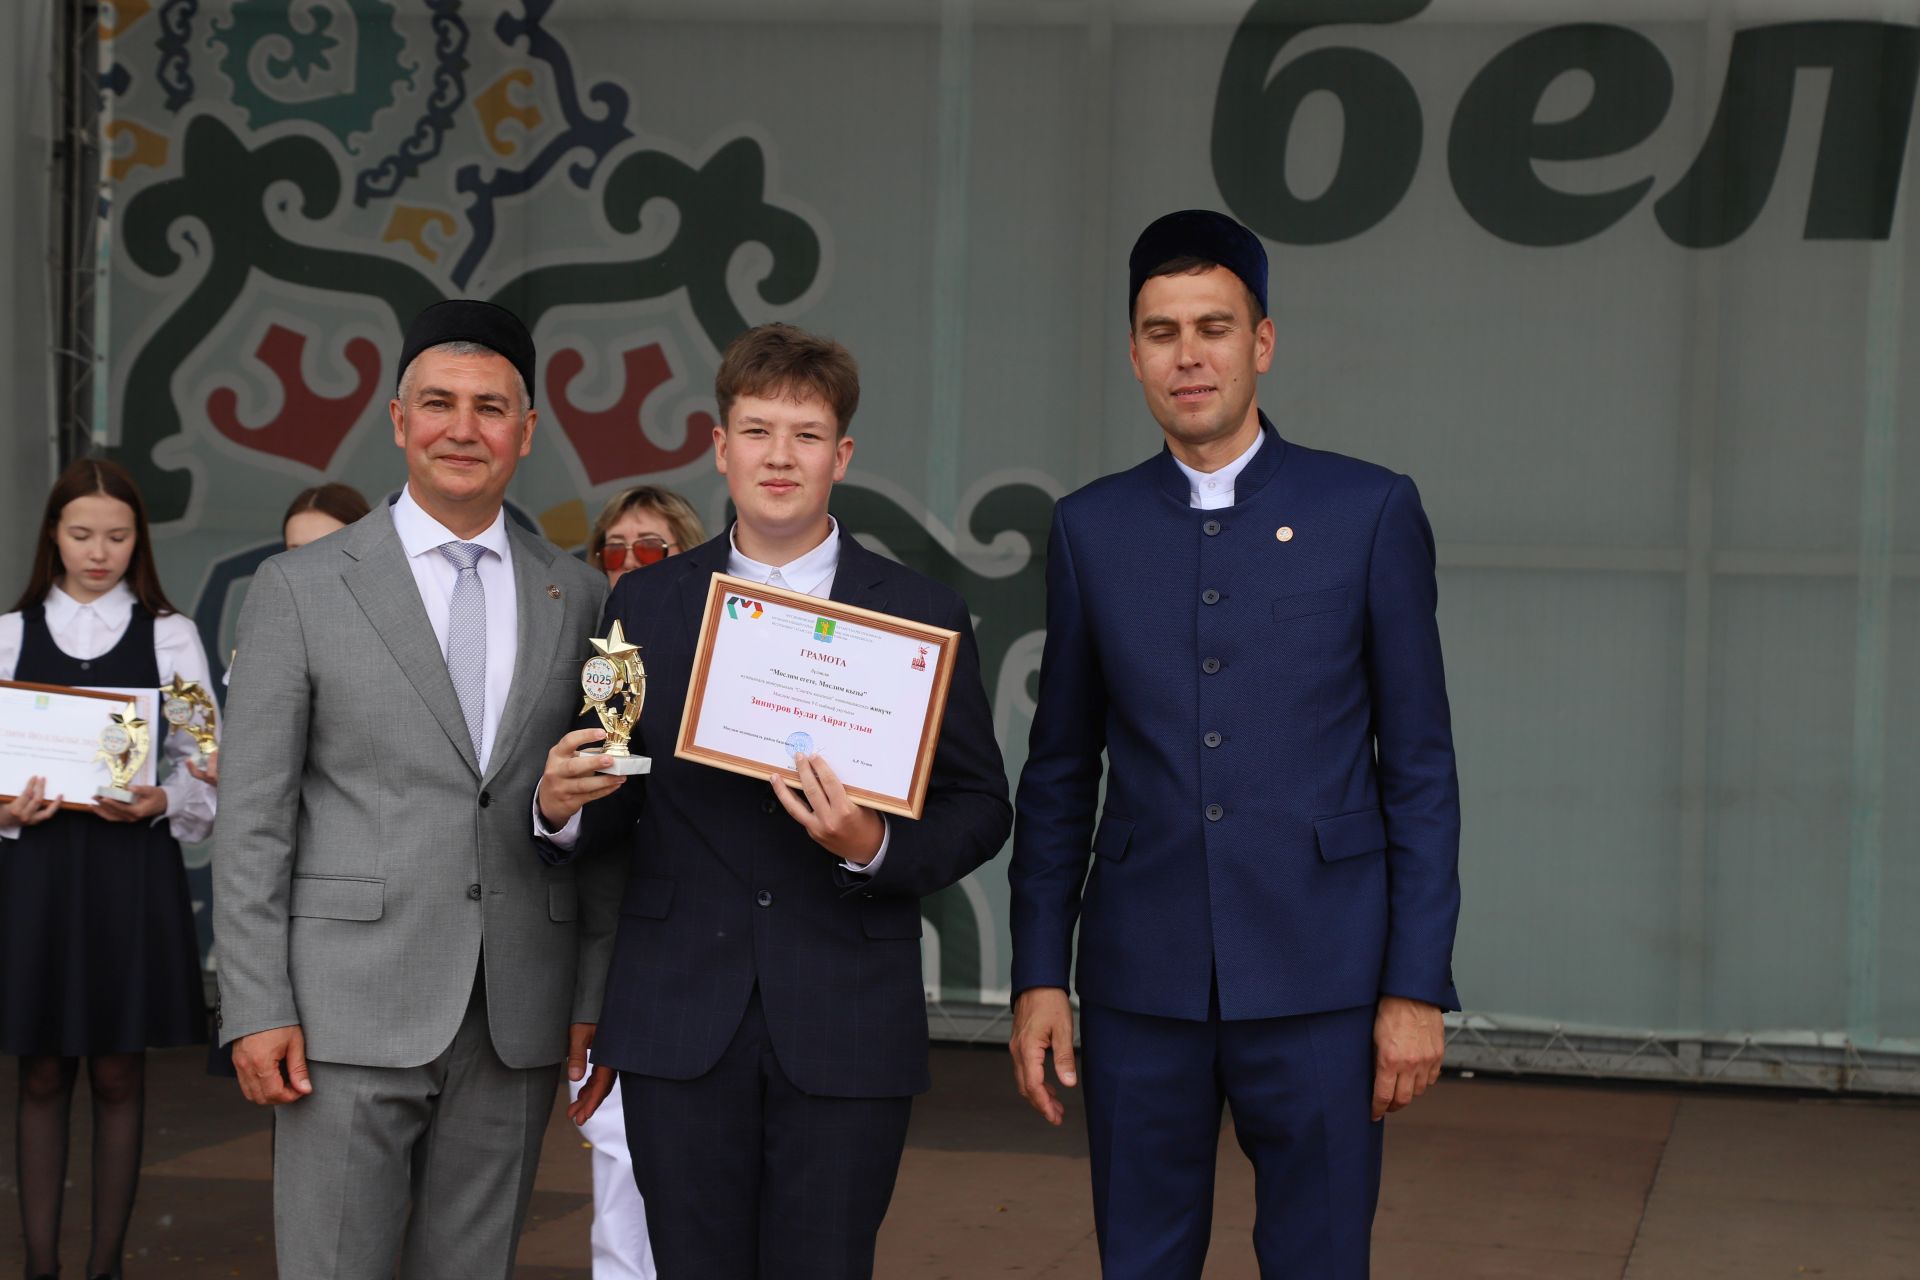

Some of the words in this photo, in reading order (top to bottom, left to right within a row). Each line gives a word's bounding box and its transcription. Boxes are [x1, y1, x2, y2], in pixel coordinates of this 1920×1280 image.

[800, 649, 846, 667] ГРАМОТА
[586, 672, 612, 685] 2025
[751, 696, 791, 713] Зиннуров
[793, 707, 818, 720] Булат
[820, 714, 847, 728] Айрат
